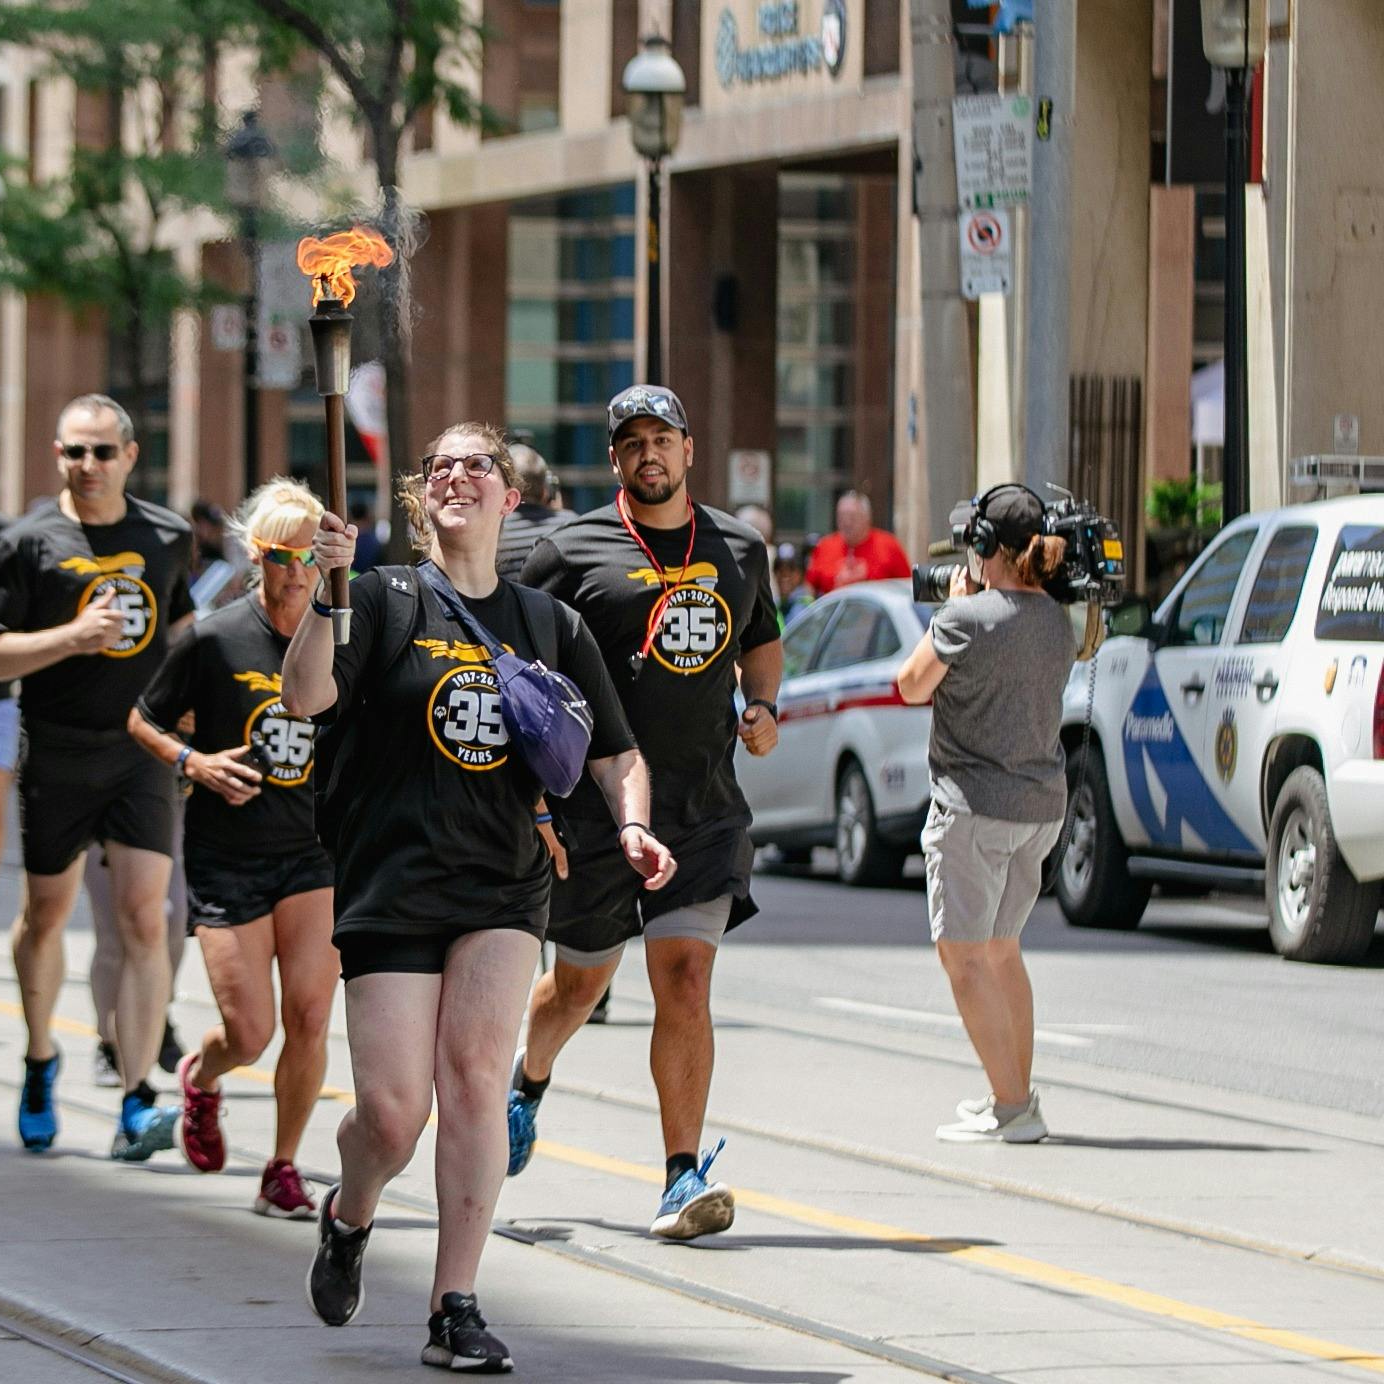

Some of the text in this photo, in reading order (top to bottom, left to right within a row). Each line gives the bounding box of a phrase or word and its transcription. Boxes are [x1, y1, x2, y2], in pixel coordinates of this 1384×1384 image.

[661, 606, 716, 652] 35
[674, 654, 704, 667] YEARS
[443, 689, 509, 746] 35
[260, 717, 315, 767] 35
[457, 746, 493, 763] YEARS
